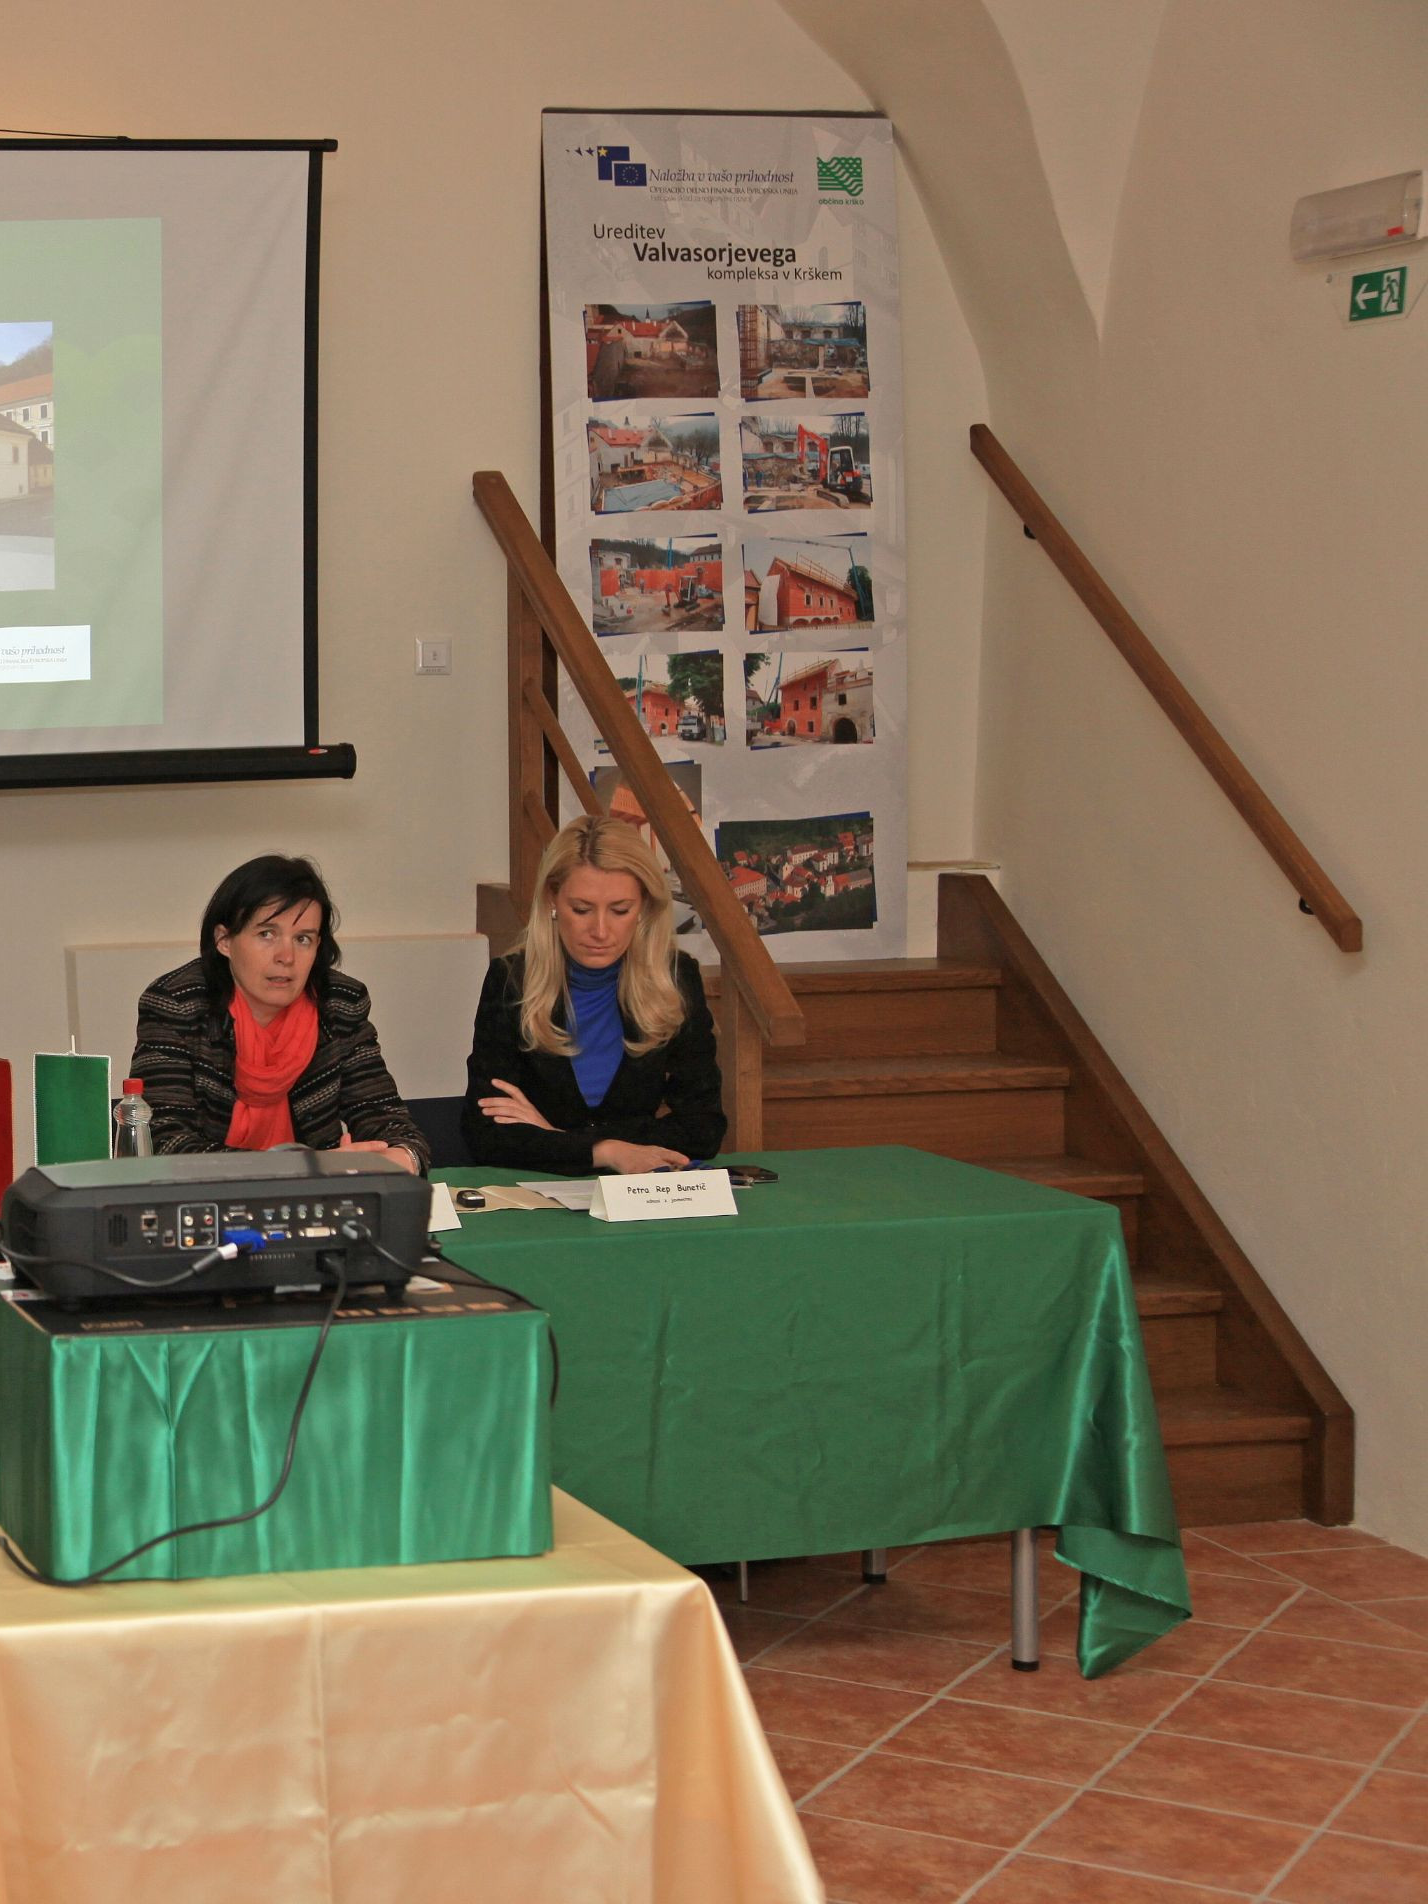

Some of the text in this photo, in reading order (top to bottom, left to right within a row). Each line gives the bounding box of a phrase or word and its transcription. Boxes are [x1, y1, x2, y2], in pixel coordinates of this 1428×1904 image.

[649, 168, 794, 186] Naložba v vašo prihodnost
[818, 197, 844, 206] občina
[593, 223, 666, 240] Ureditev
[633, 242, 797, 267] Valvasorjevega
[707, 266, 843, 283] kompleksa v Krškem
[627, 1186, 650, 1195] Petra
[656, 1185, 671, 1194] Rep
